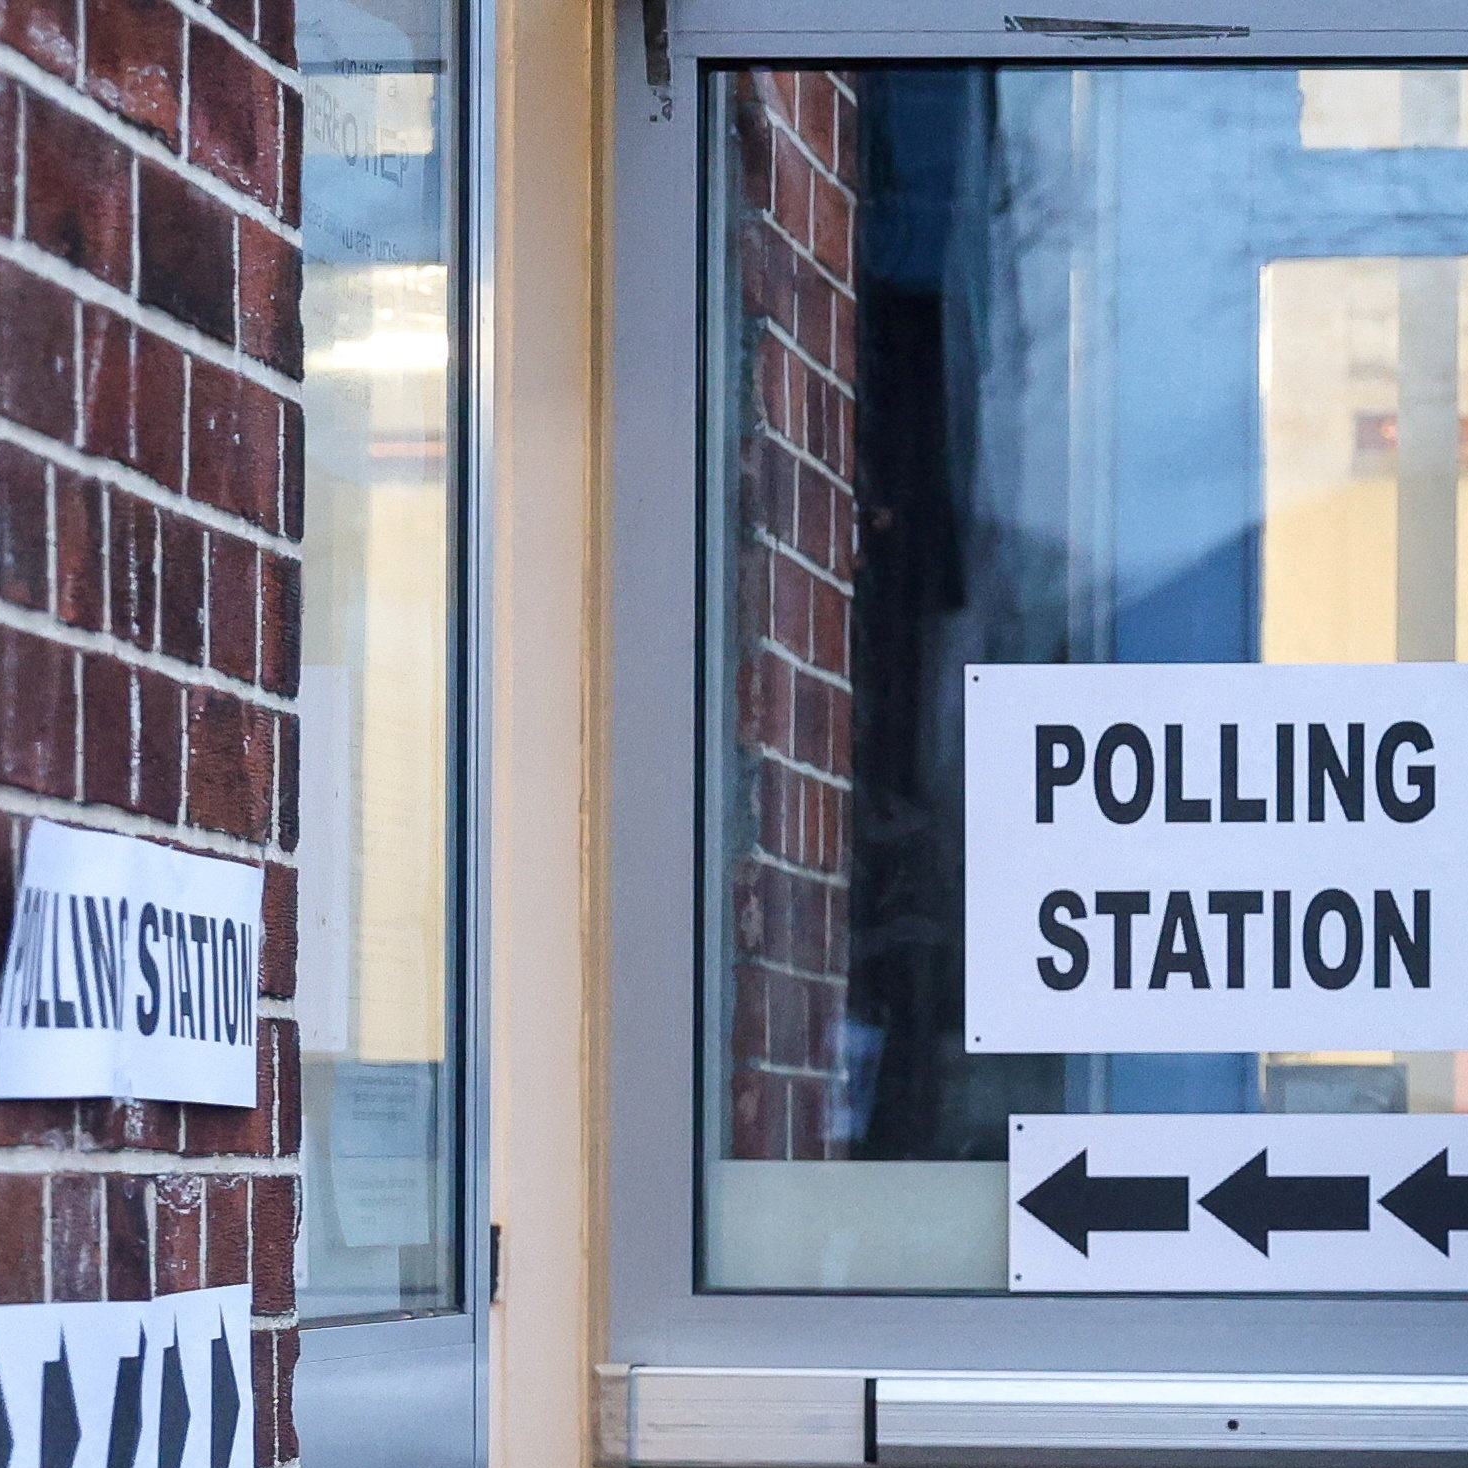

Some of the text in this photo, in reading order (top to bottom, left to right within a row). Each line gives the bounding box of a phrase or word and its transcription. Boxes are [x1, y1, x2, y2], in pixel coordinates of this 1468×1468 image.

[1034, 720, 1437, 825] POLLING
[136, 901, 253, 1047] STATION
[1036, 888, 1431, 990] STATION
